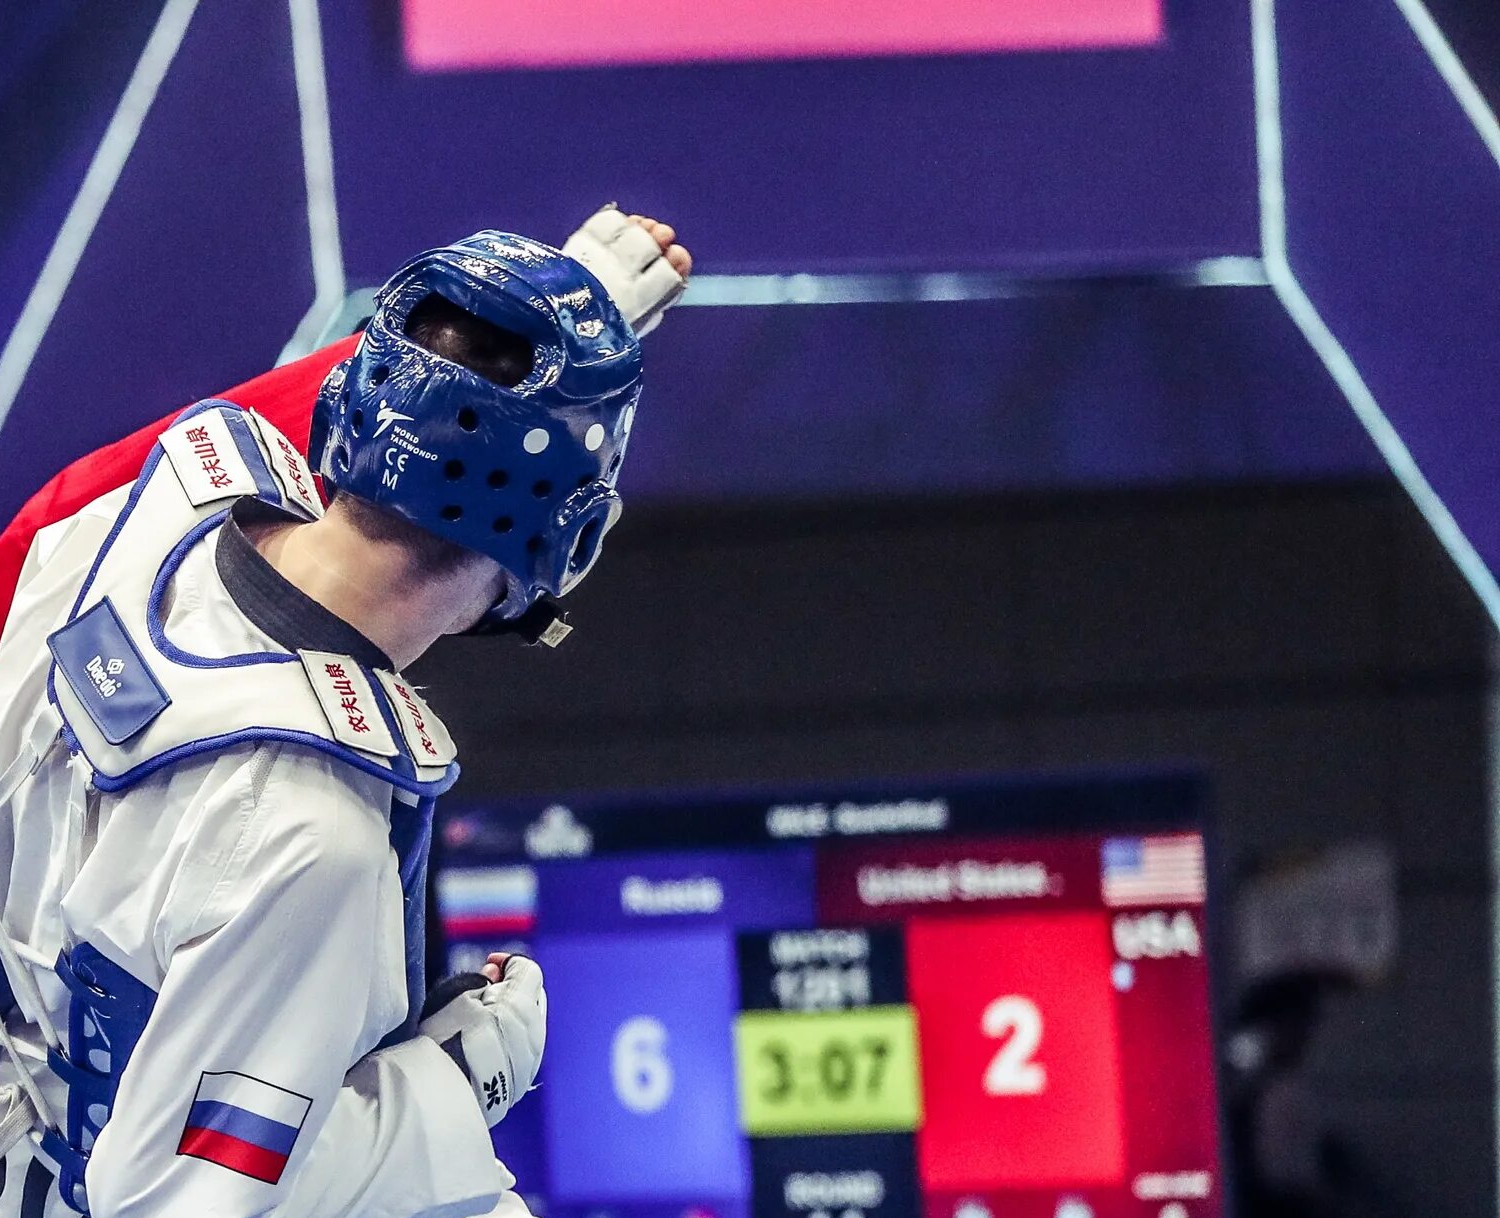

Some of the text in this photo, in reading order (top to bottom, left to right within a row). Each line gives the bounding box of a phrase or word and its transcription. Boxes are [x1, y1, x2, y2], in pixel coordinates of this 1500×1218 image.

[187, 424, 234, 490] 农夫山泉
[389, 434, 439, 461] TAEKWONDO
[393, 425, 420, 443] WORLD
[381, 468, 399, 491] M
[86, 655, 118, 698] Daedo
[324, 661, 368, 735] 农夫山泉
[1111, 911, 1202, 962] USA
[610, 1015, 674, 1115] 6
[981, 994, 1047, 1097] 2
[759, 1042, 890, 1108] 3:07
